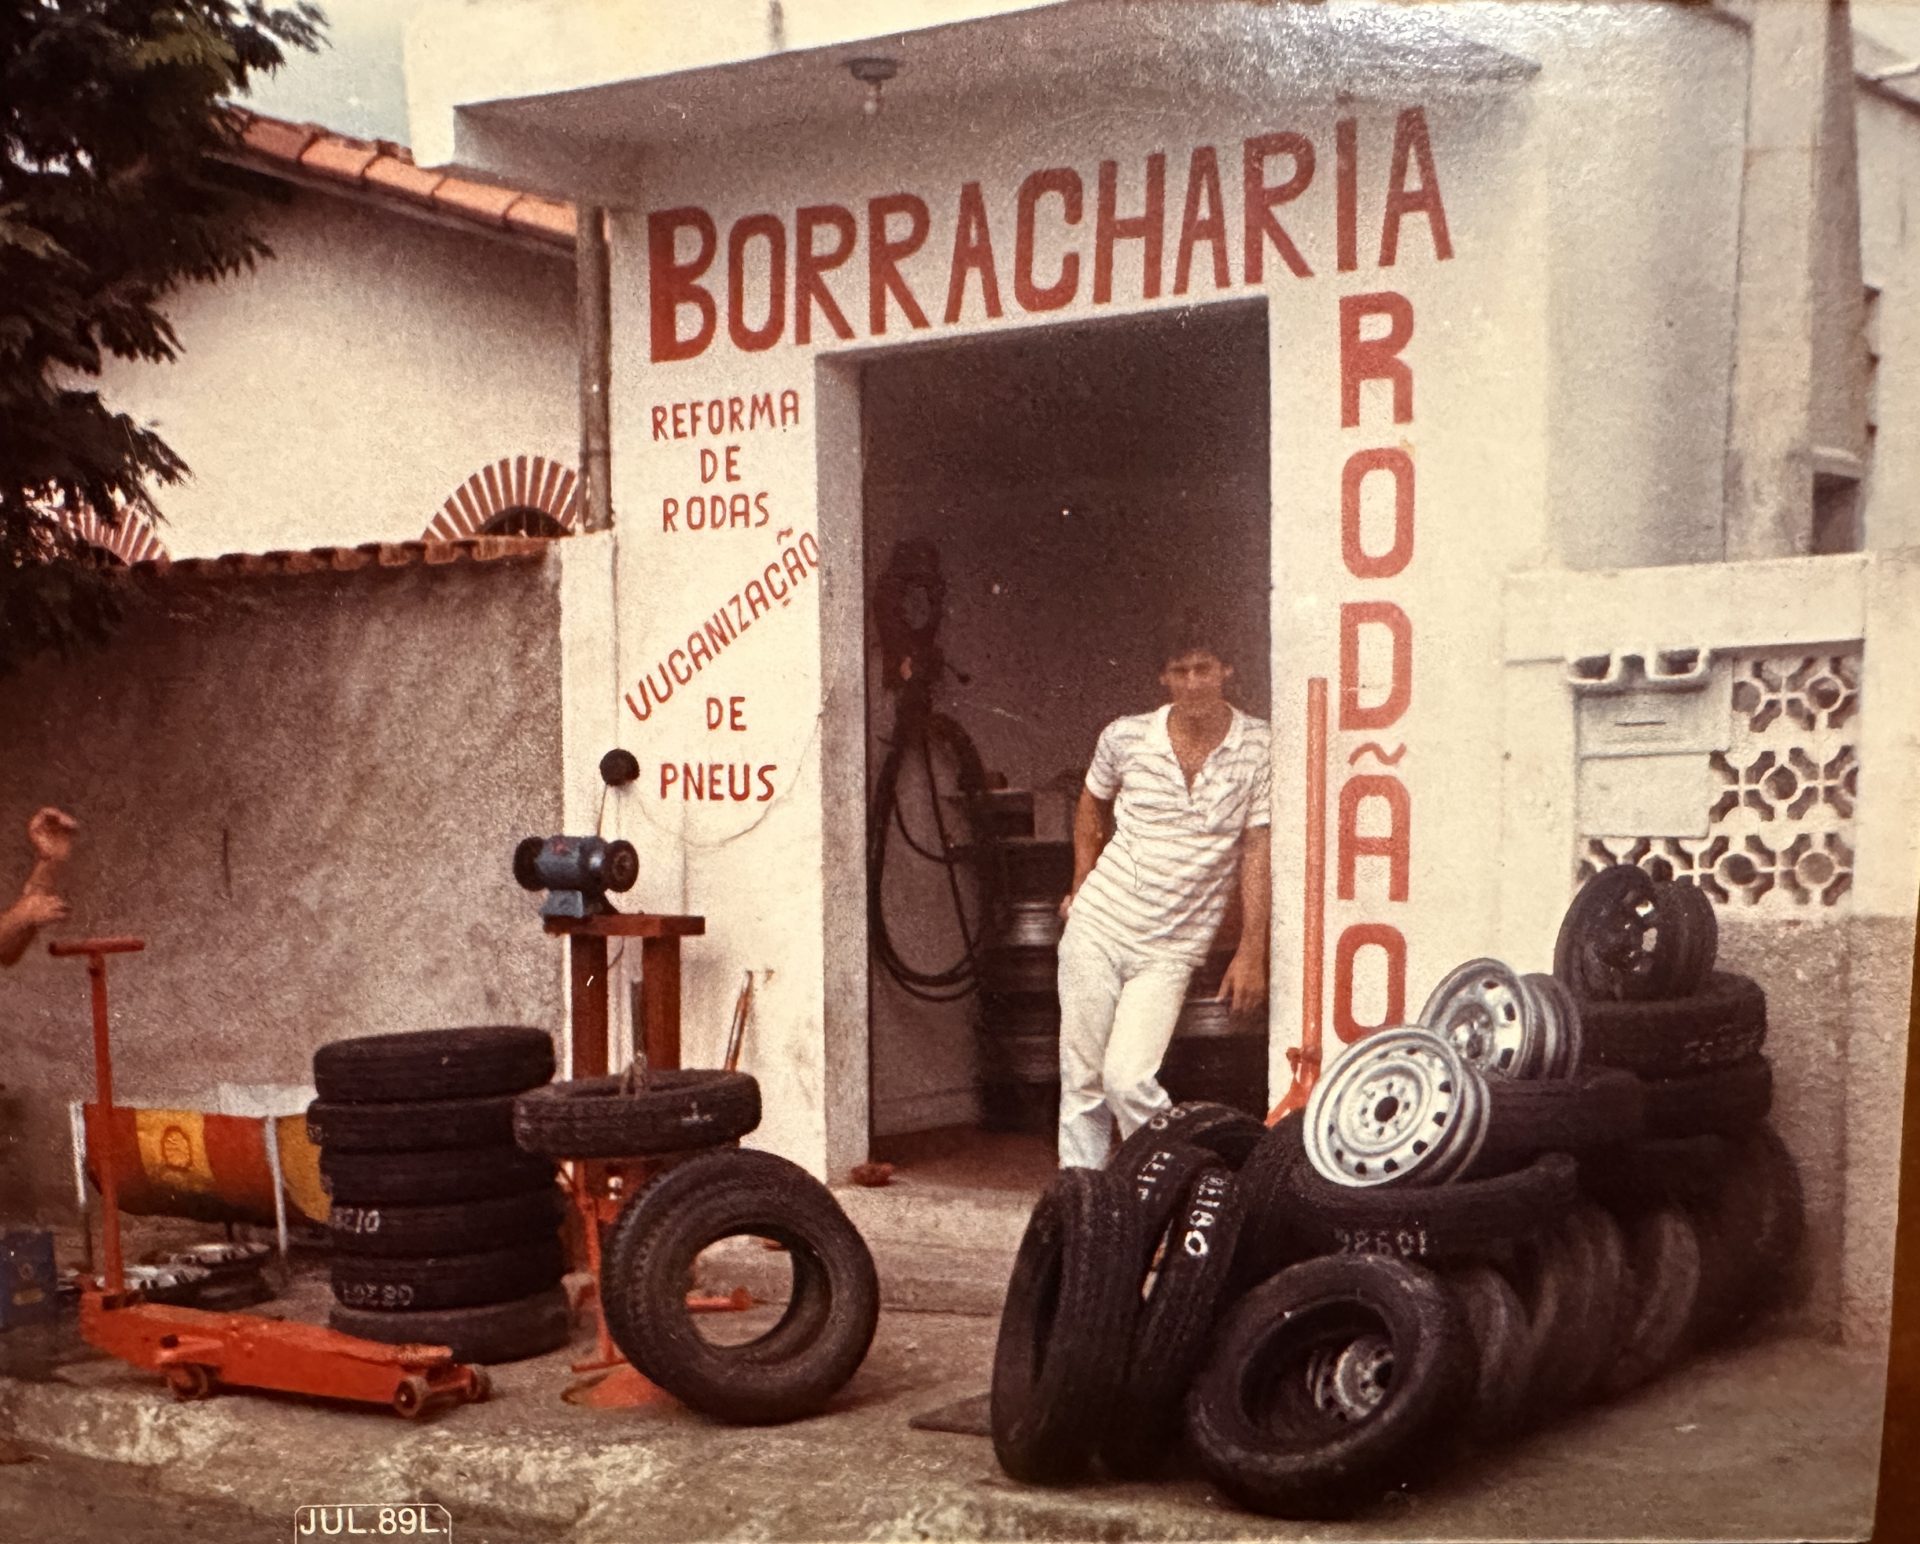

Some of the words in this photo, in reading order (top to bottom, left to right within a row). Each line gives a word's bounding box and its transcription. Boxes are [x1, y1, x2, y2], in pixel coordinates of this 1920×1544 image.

[648, 105, 1454, 364] BORRACHARIA
[651, 390, 800, 441] REFORMA
[700, 446, 742, 484] DE
[662, 491, 770, 532] RODAS
[1333, 290, 1414, 1045] RODÃO
[706, 696, 748, 731] DE
[659, 763, 778, 801] PNEUS
